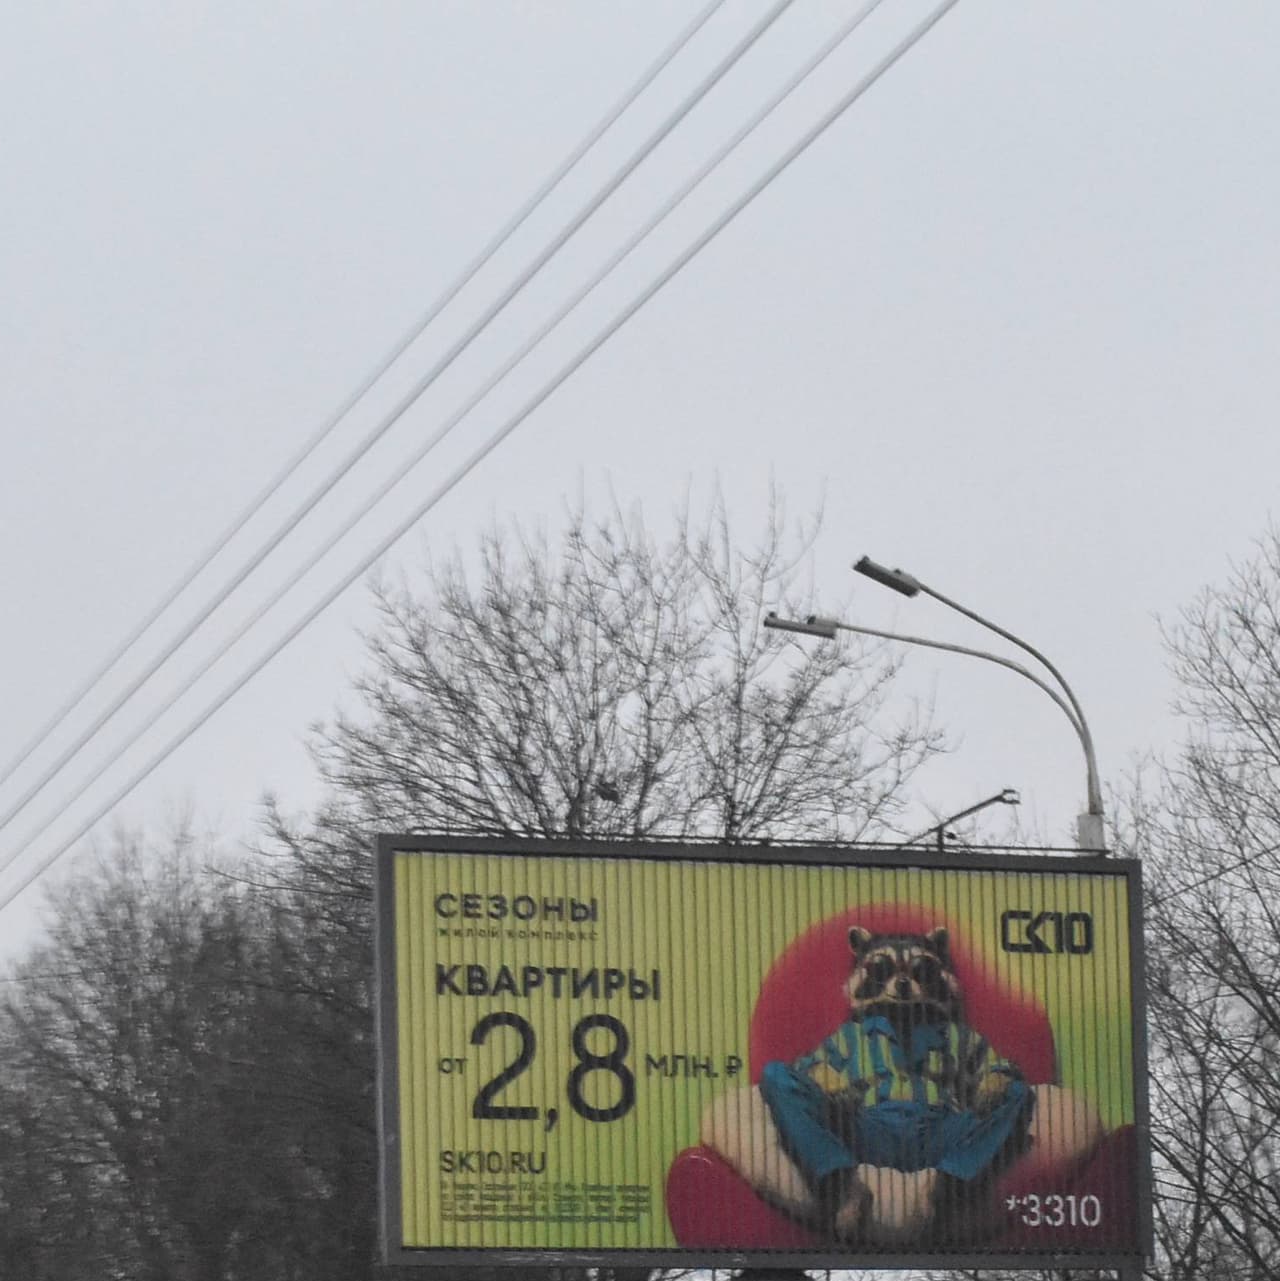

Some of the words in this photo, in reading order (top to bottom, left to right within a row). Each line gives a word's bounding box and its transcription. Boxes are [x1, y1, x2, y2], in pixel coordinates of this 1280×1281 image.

[434, 893, 598, 922] СЕЗОНЫ
[507, 928, 599, 941] комплекс
[436, 963, 661, 1001] КВАРТИРЫ
[471, 1011, 637, 1132] 2,8
[440, 1151, 546, 1175] SK10.RU
